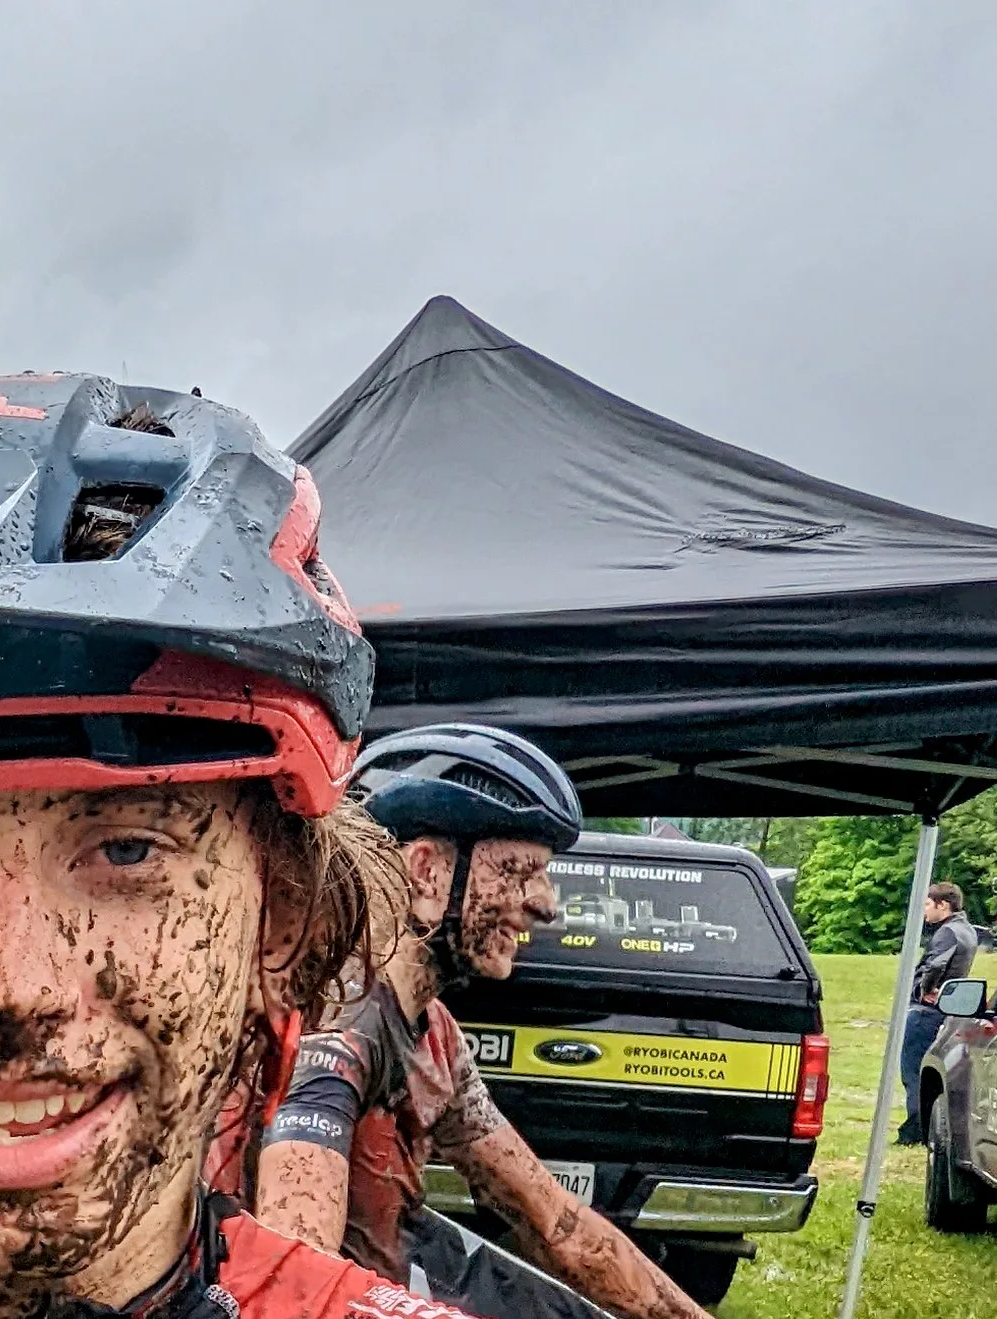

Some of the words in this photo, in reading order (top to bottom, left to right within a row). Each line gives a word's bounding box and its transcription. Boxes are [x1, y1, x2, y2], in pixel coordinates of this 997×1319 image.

[546, 860, 605, 876] RDLESS
[609, 864, 702, 884] REVOLUTION
[560, 935, 596, 948] 40V
[464, 1032, 509, 1061] OBI
[624, 1045, 728, 1063] @RYOBICANADA
[624, 1064, 726, 1081] RYOBITOOLS.CA
